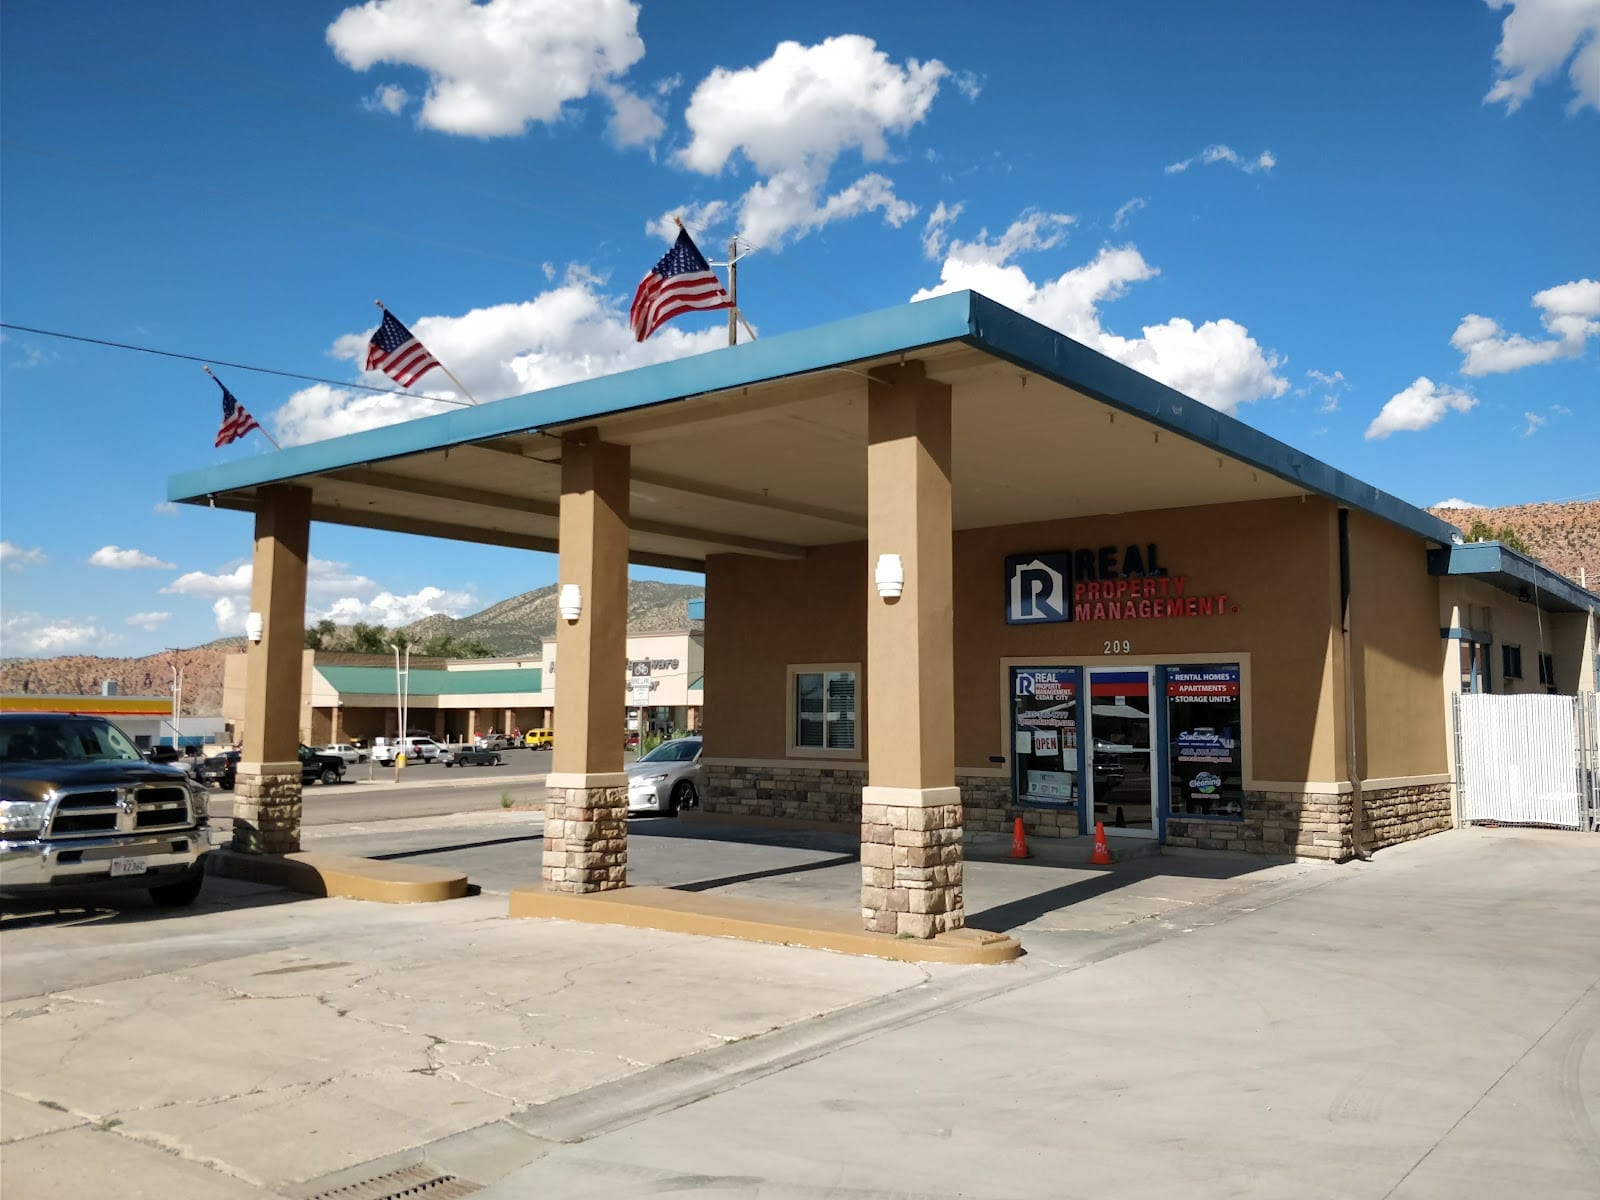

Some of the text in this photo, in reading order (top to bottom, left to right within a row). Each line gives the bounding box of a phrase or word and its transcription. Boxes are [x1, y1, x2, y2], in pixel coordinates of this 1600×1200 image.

[1075, 544, 1168, 580] REAL
[1075, 578, 1186, 600] PROPERTY
[1075, 596, 1228, 623] MANAGEMENT
[1103, 640, 1130, 654] 209
[1035, 673, 1058, 683] REAL
[1036, 738, 1056, 750] OPEN
[1189, 778, 1221, 788] Cleaning
